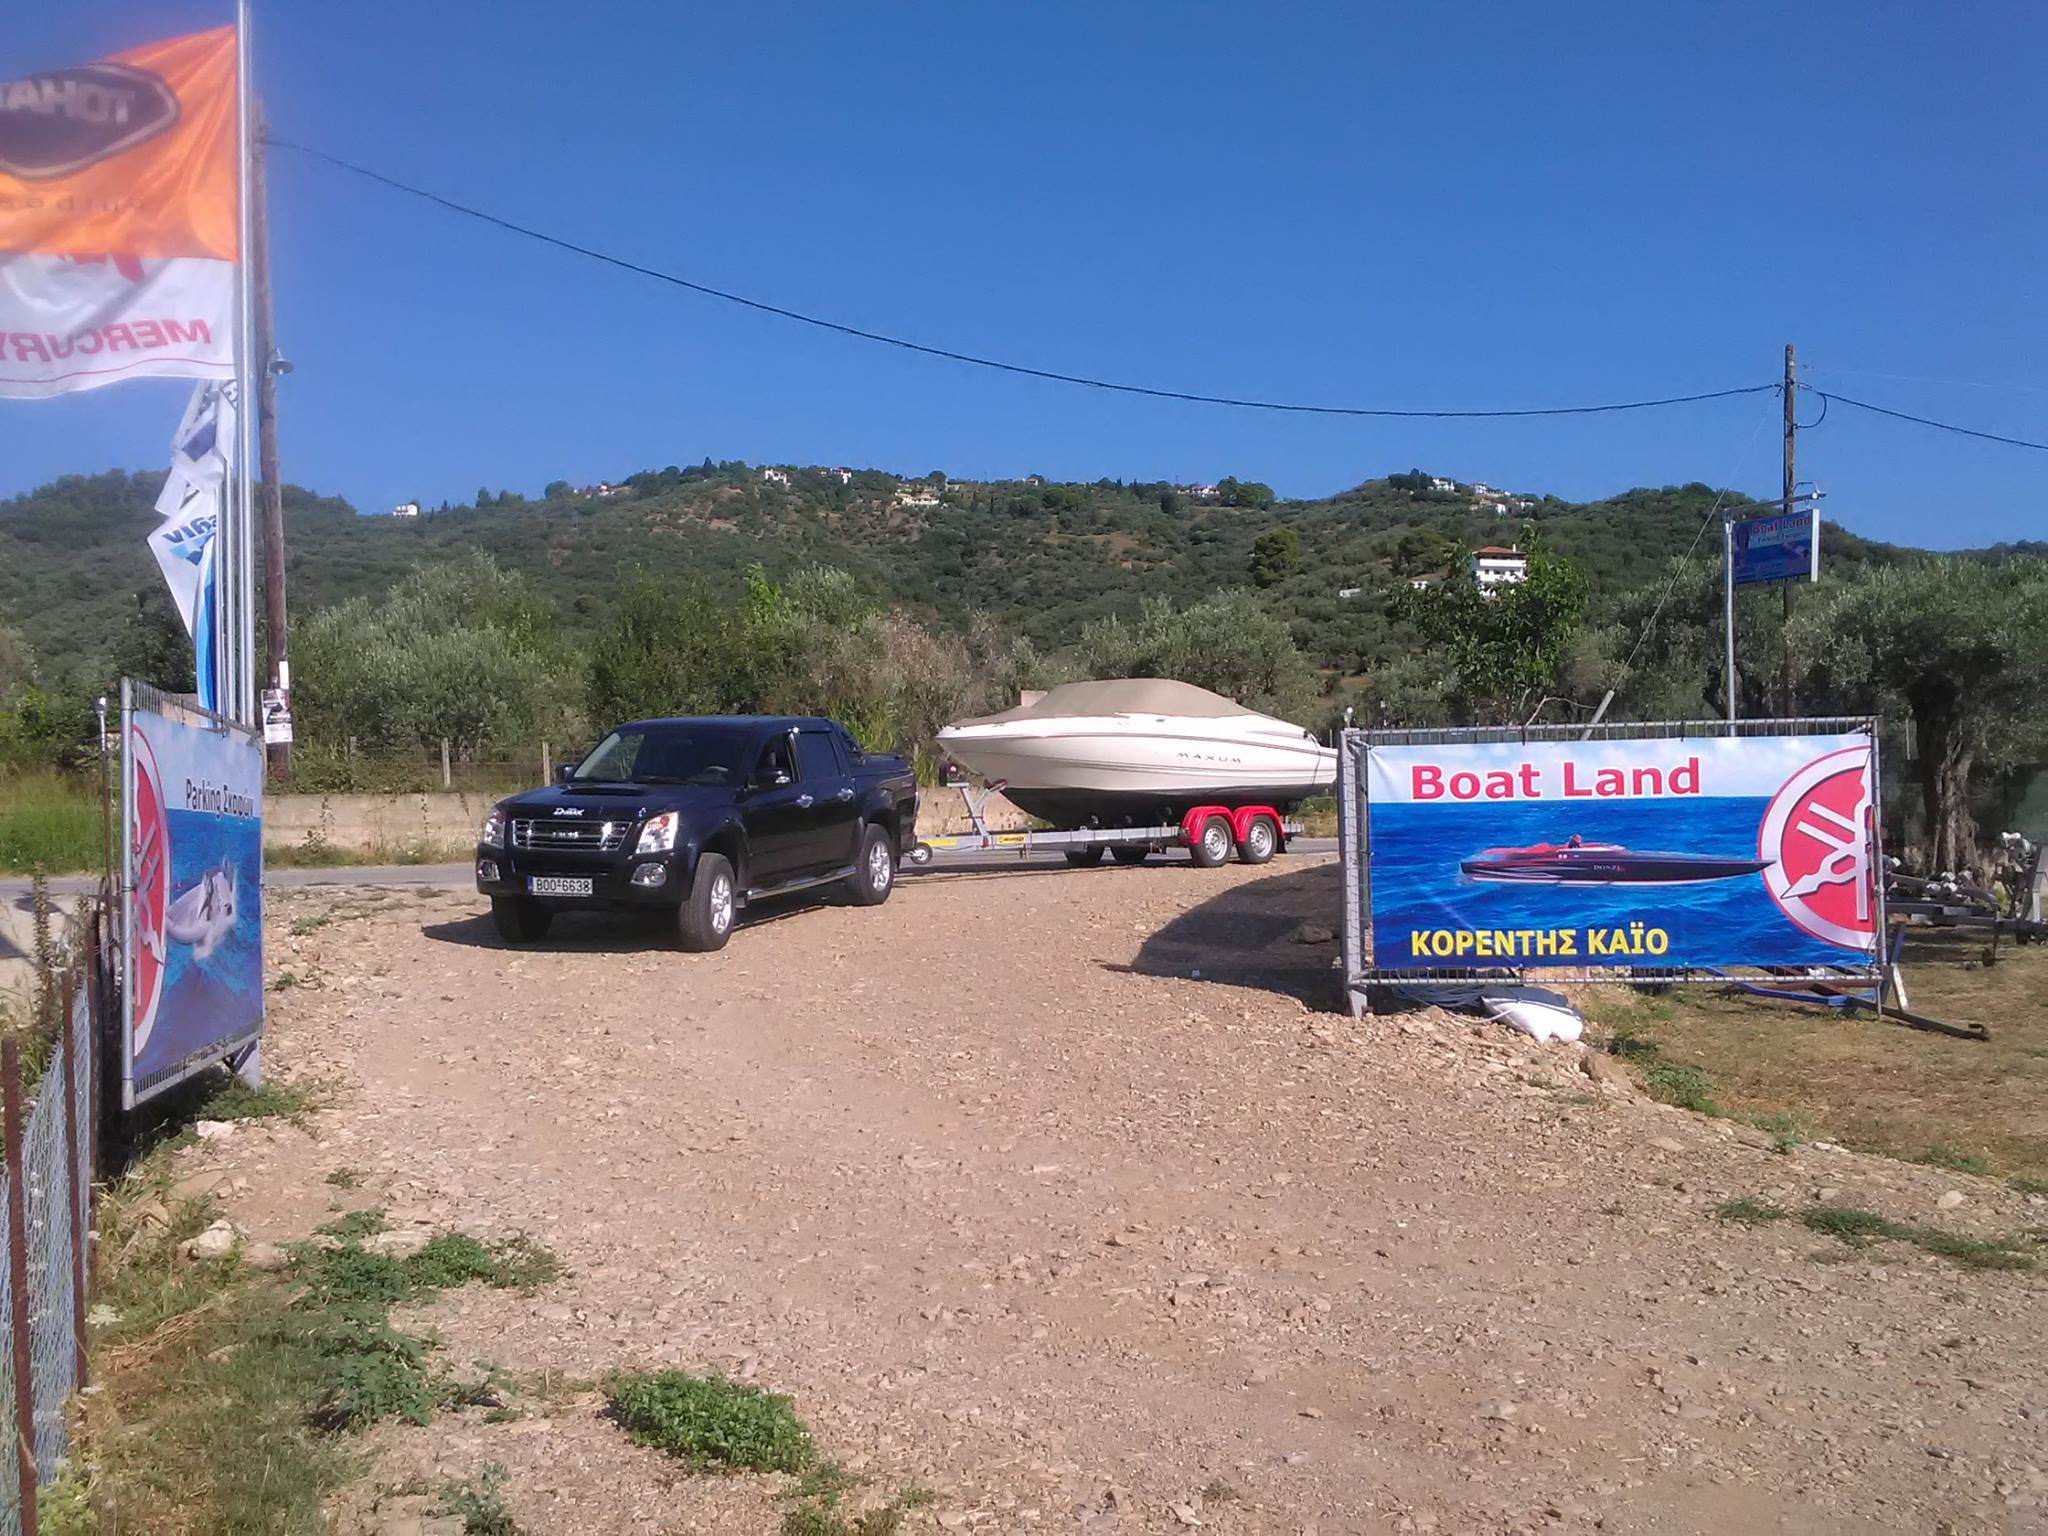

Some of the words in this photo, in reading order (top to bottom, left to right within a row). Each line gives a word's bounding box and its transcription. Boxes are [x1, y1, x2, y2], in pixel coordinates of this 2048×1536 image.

[1175, 752, 1241, 764] MAXUM
[1411, 763, 1541, 800] Boat
[1563, 757, 1700, 797] Land
[185, 778, 222, 819] Parking
[1411, 929, 1577, 956] ΚΟΡΕΝΤΗΣ
[1588, 922, 1669, 955] ΚΑΪΟ
